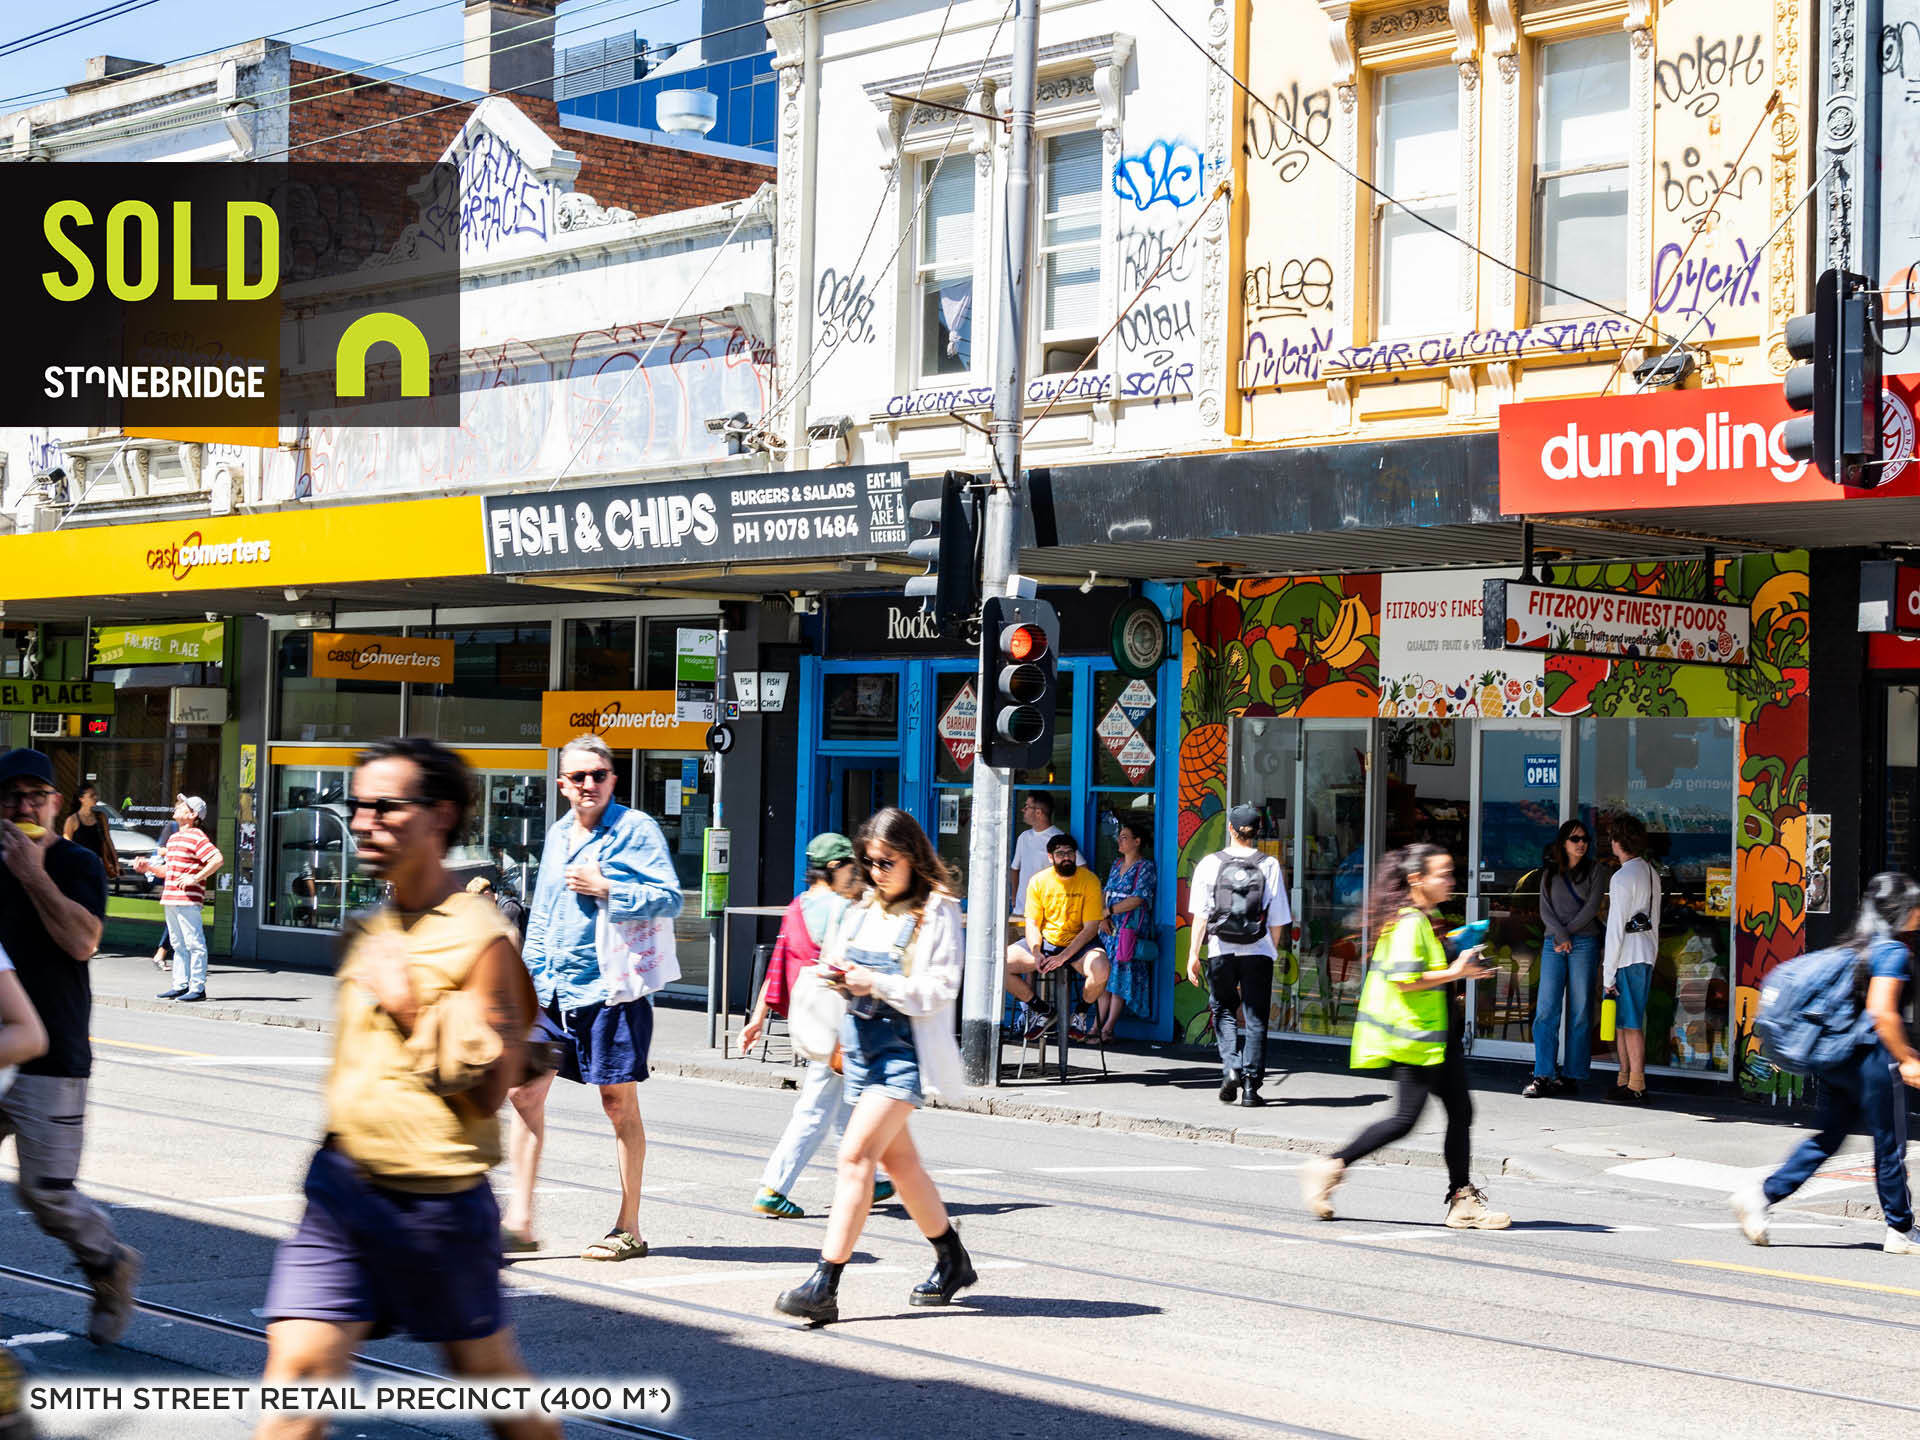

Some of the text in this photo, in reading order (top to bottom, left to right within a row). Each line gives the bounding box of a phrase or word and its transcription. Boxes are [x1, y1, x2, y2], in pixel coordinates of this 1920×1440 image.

[1541, 412, 1808, 486] dumpling
[866, 471, 902, 490] EAT-IN
[730, 481, 856, 506] BURGERS & SALADS
[868, 494, 894, 510] WE
[491, 492, 719, 557] FISH & CHIPS
[870, 509, 895, 526] ARE
[733, 514, 860, 545] PH 9078 1484
[870, 529, 906, 543] LICENSED
[1386, 600, 1448, 620] FITZROY'S
[1529, 590, 1727, 632] FITZROY'S FINEST FOODS
[124, 631, 200, 658] FALAFEL PLACE
[1570, 628, 1590, 641] fresh
[1590, 631, 1610, 643] fruits
[1610, 633, 1624, 644] and
[766, 677, 780, 686] FISH
[31, 683, 93, 705] PLACE
[740, 699, 758, 708] CHIPS
[761, 699, 781, 708] CHIPS
[702, 708, 713, 720] 18
[1527, 767, 1557, 784] OPEN
